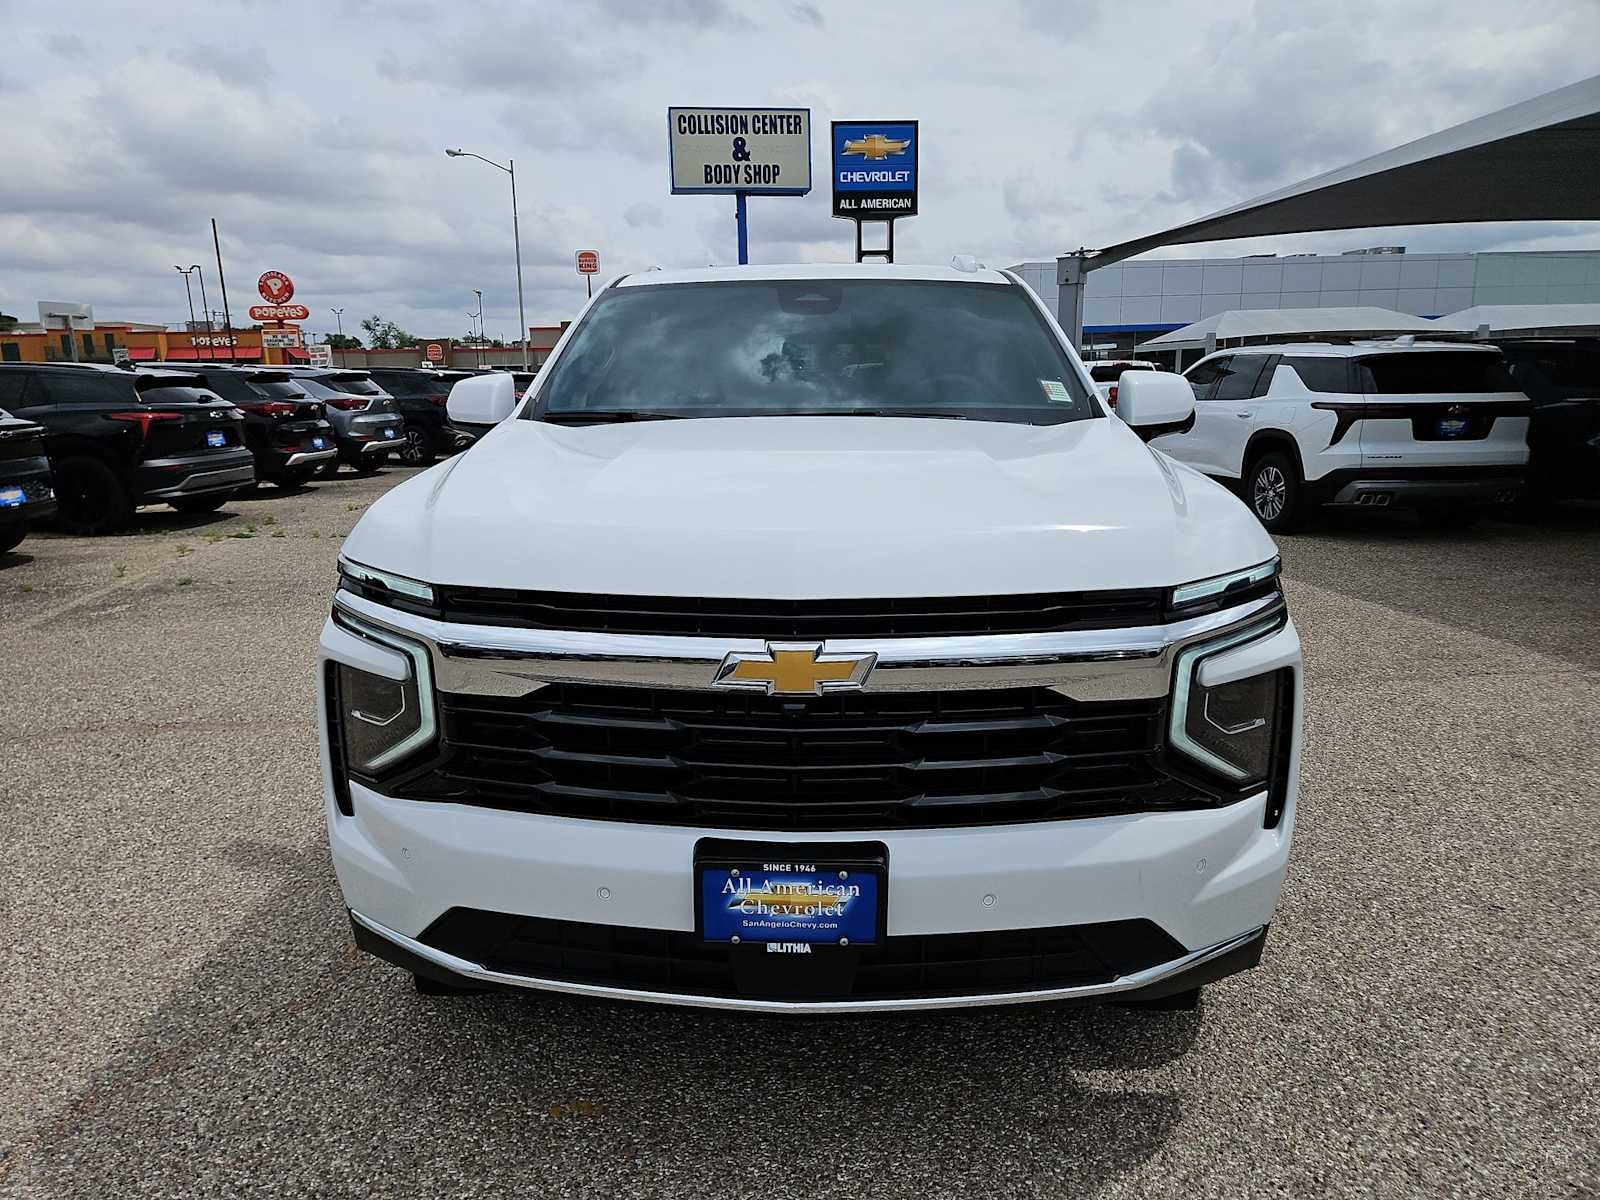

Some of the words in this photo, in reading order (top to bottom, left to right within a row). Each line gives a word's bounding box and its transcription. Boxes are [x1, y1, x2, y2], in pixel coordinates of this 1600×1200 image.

[677, 114, 748, 135] COLLISION
[751, 114, 802, 135] CENTER
[732, 136, 751, 162] &
[703, 164, 740, 185] BODY
[743, 164, 780, 185] SHOP
[839, 170, 910, 183] CHEVROLET
[839, 198, 858, 209] ALL
[860, 198, 911, 209] AMERICAN
[254, 306, 304, 318] POPEYES
[763, 863, 791, 872] SINCE
[794, 864, 816, 873] 1946
[721, 878, 751, 894] All
[760, 879, 860, 897] American
[740, 900, 844, 917] Chevrolet
[742, 919, 838, 930] SanAngeloChevy.com
[777, 942, 812, 953] LITHIA
